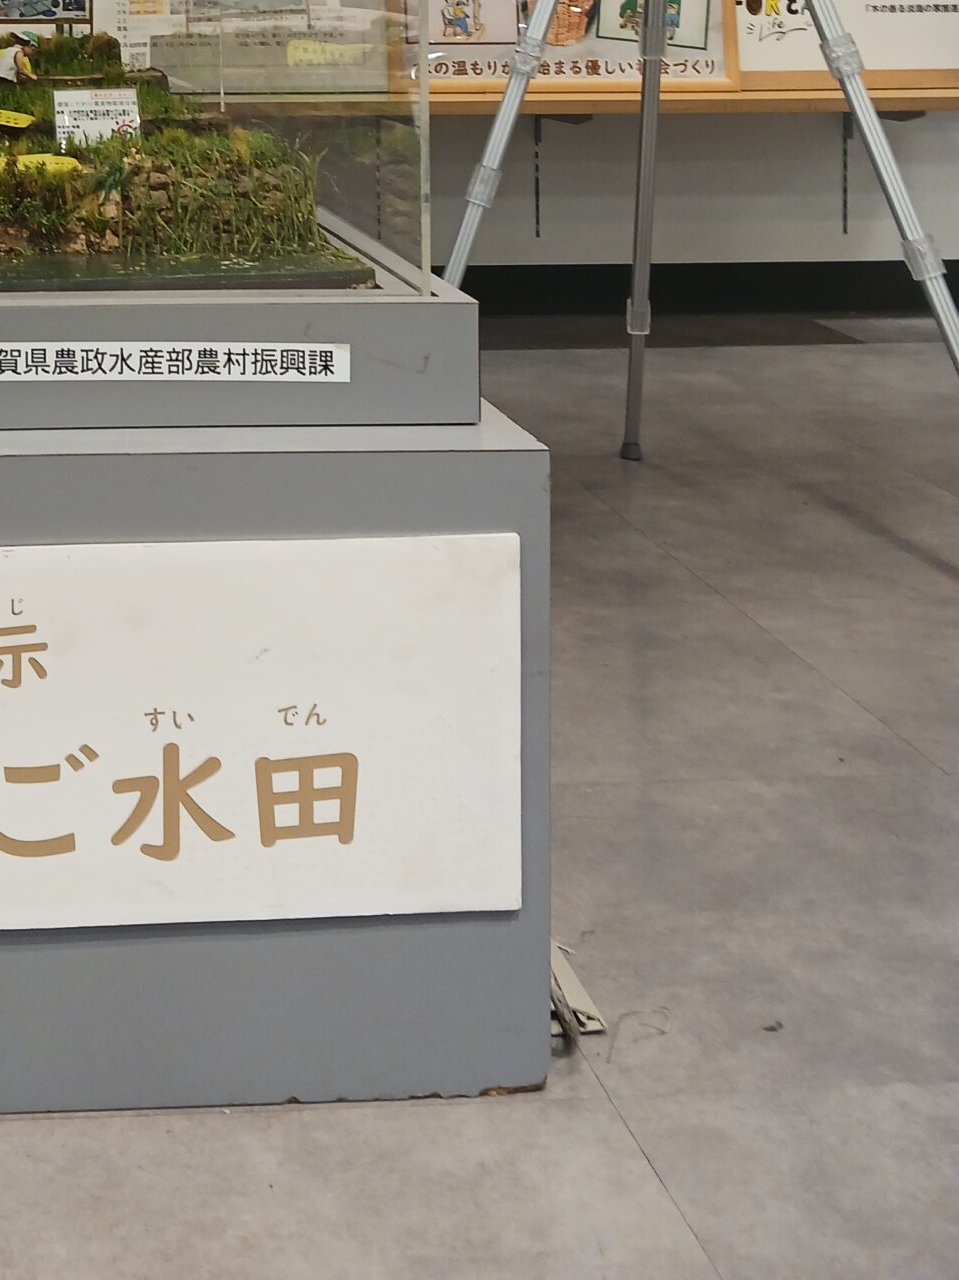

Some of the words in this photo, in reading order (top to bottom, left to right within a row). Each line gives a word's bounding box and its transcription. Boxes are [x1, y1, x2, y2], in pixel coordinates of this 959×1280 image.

[7, 596, 26, 616] じ
[143, 707, 195, 732] すい
[277, 702, 328, 730] でん
